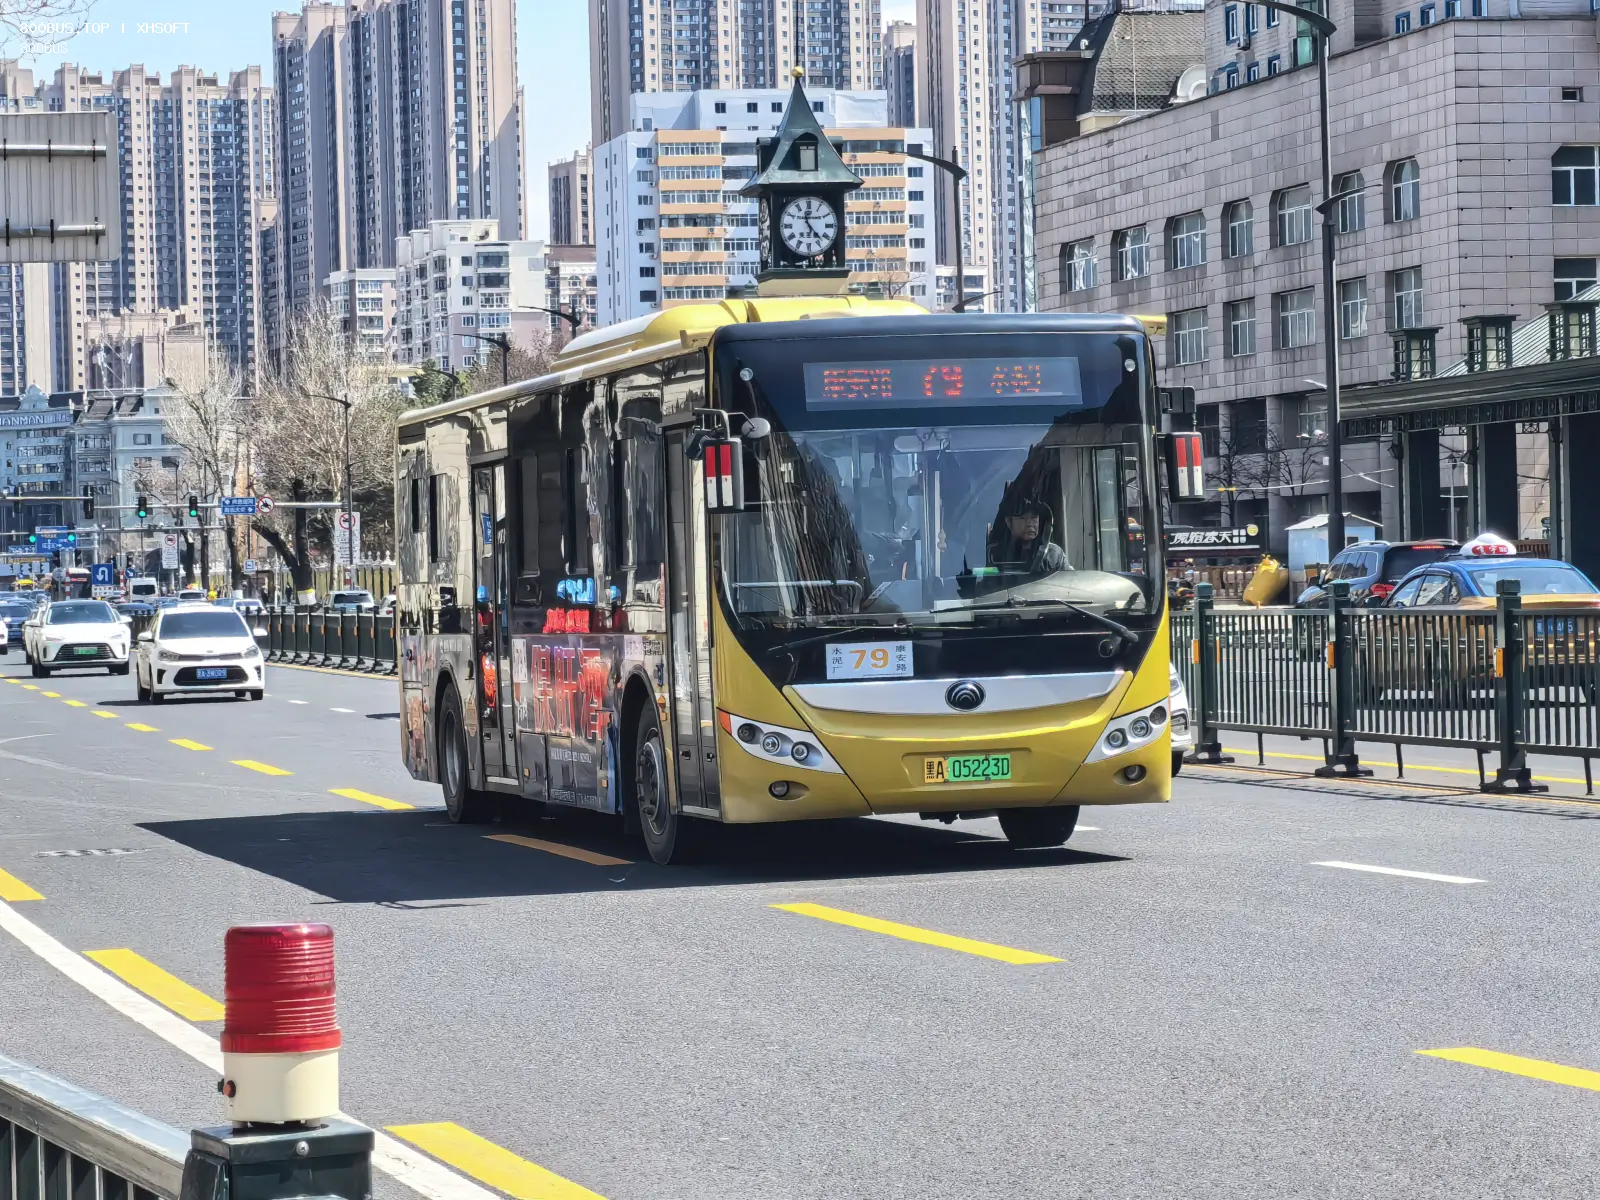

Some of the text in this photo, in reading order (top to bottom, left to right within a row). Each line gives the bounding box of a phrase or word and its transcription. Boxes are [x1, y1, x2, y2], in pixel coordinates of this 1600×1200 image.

[0, 414, 44, 426] ANMAN
[831, 646, 843, 674] 水泥厂
[848, 648, 889, 670] 79
[895, 644, 907, 672] 康安路
